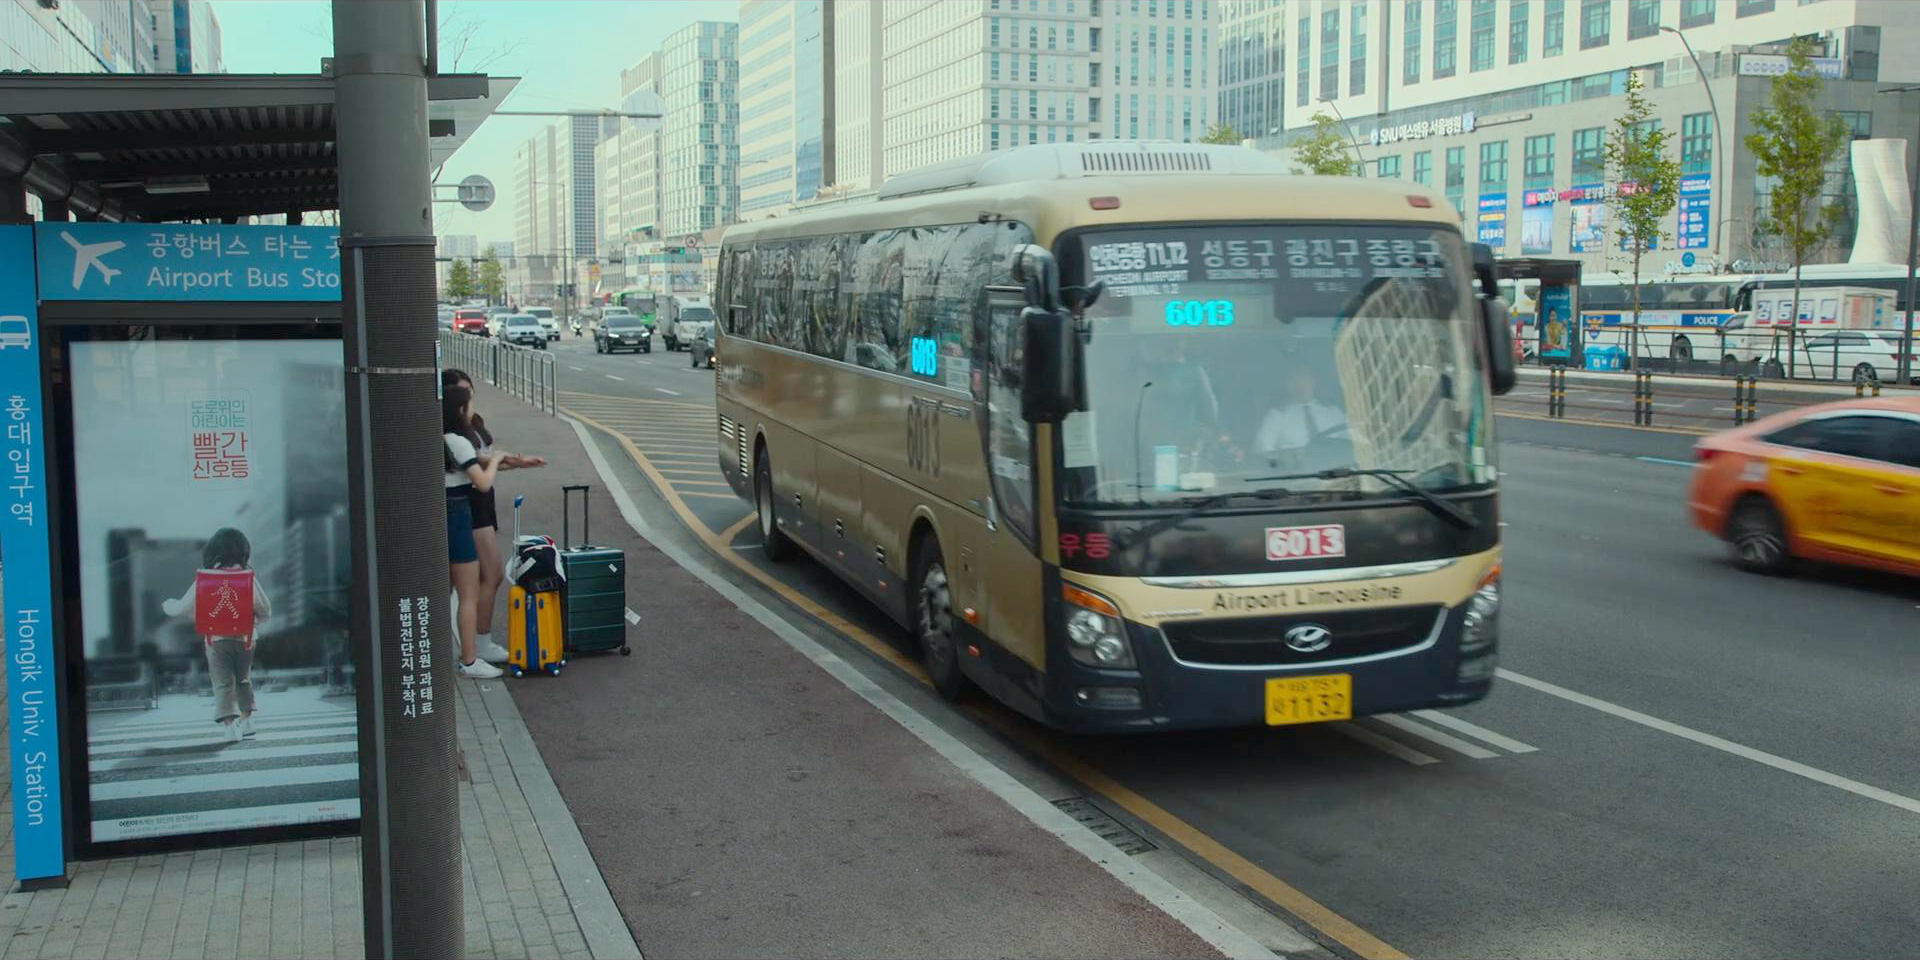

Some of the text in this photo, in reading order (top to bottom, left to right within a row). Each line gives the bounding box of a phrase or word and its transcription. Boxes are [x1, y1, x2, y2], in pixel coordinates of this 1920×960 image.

[146, 233, 250, 259] 공항버스
[264, 234, 313, 260] 타는
[1200, 239, 1275, 268] 성동구
[1283, 239, 1361, 267] 광진구
[147, 266, 340, 292] Airport Bus Sto
[1165, 300, 1234, 327] 6013
[1693, 315, 1719, 325] POLICE
[191, 414, 246, 428] 어린이는
[193, 431, 249, 460] 빨간
[5, 395, 34, 526] 홍대입구역
[193, 459, 249, 479] 신호등
[1060, 532, 1111, 559] 우등
[1268, 527, 1343, 558] 6013
[1212, 584, 1403, 613] Airport Limousine
[398, 597, 416, 719] 불법전단지 부착시
[416, 595, 435, 715] 장당5만원 과태료
[16, 609, 48, 827] Hongik Univ. Station
[1289, 692, 1345, 719] 1132
